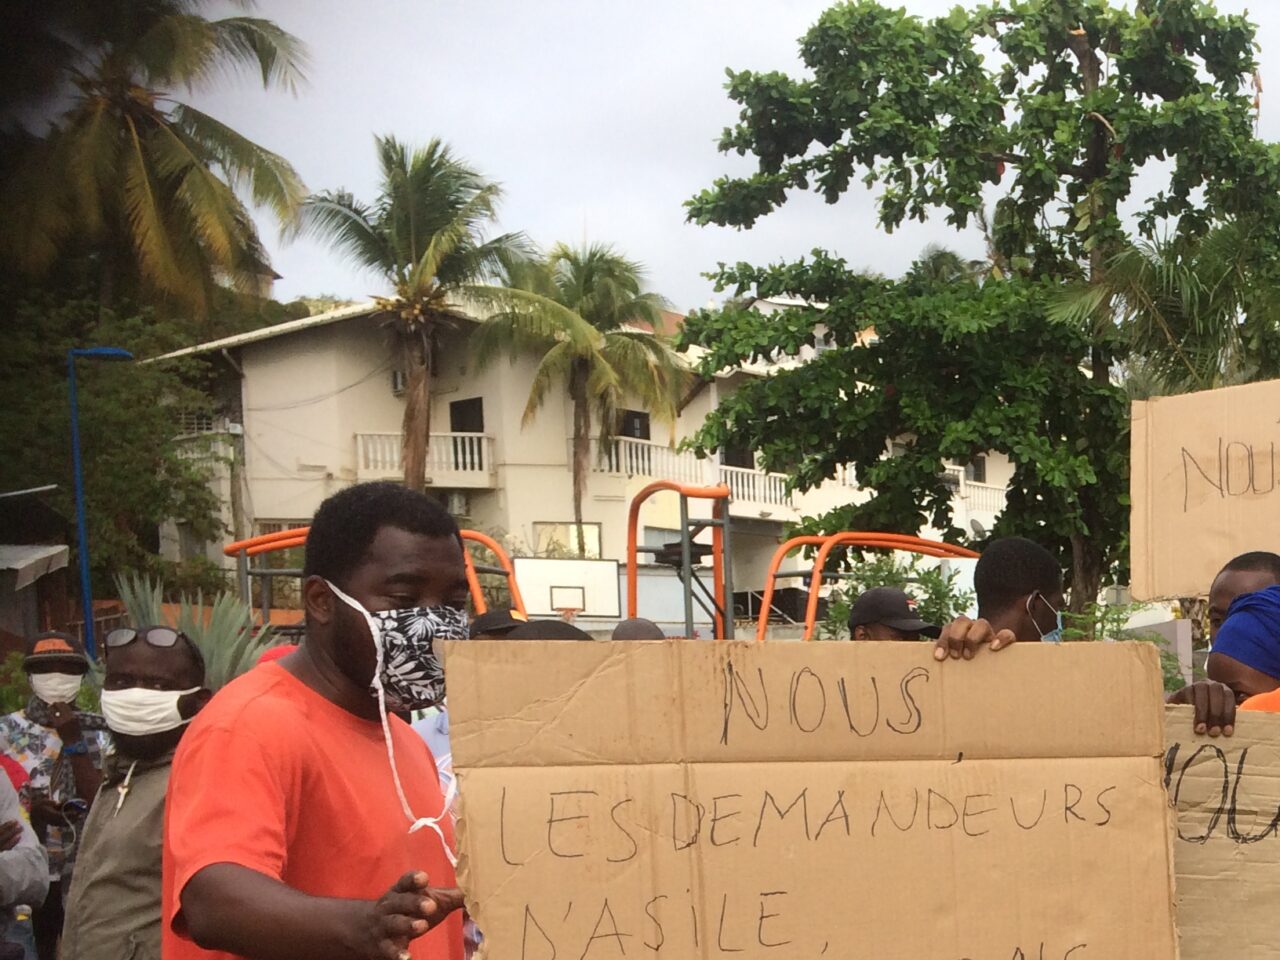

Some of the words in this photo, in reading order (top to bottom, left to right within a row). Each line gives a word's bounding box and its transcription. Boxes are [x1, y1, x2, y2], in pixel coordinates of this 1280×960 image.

[719, 659, 931, 746] NOUS
[499, 785, 639, 867] LES
[671, 782, 1114, 852] DEMANDEURS
